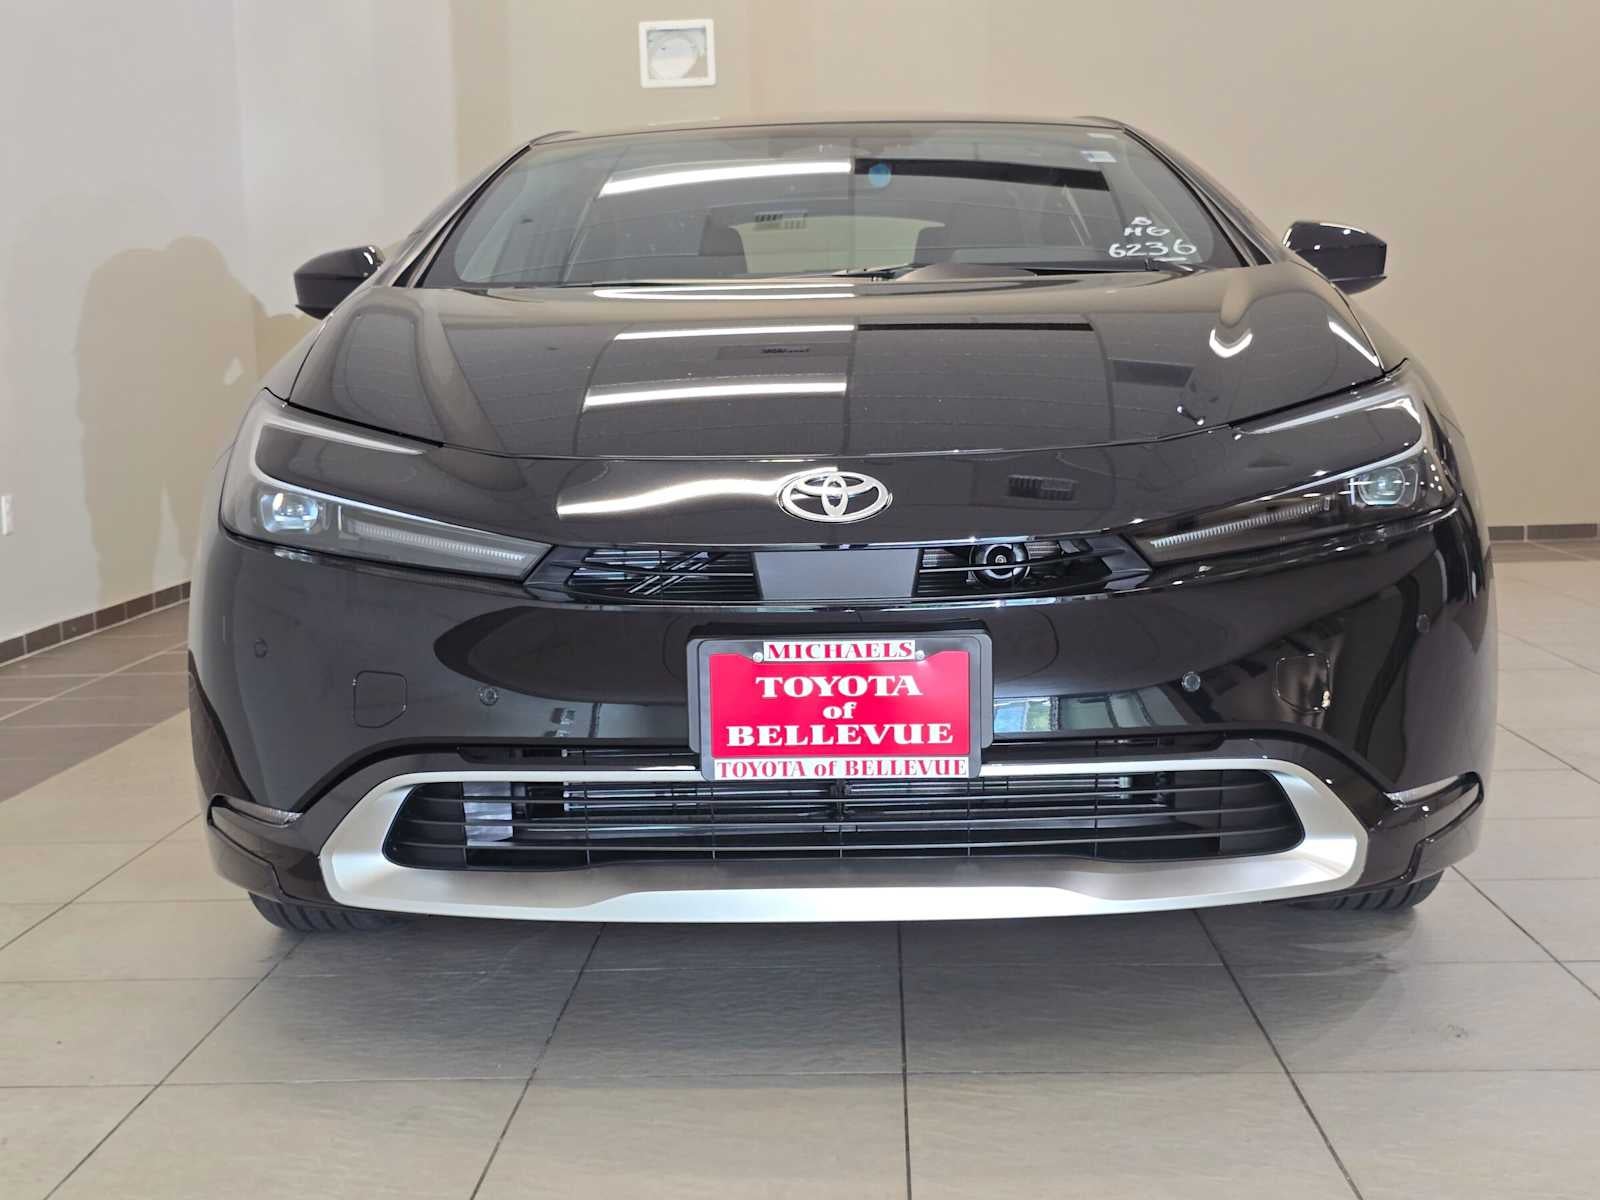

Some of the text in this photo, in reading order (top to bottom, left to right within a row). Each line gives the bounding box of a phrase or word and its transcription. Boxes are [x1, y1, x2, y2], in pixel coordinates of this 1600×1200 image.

[1108, 239, 1197, 258] 6236
[768, 641, 913, 660] MICHAELS
[755, 675, 923, 698] TOYOTA
[823, 702, 857, 719] of
[726, 723, 954, 747] BELLEVUE
[717, 759, 967, 778] TOYOTA of BELLEVUE
